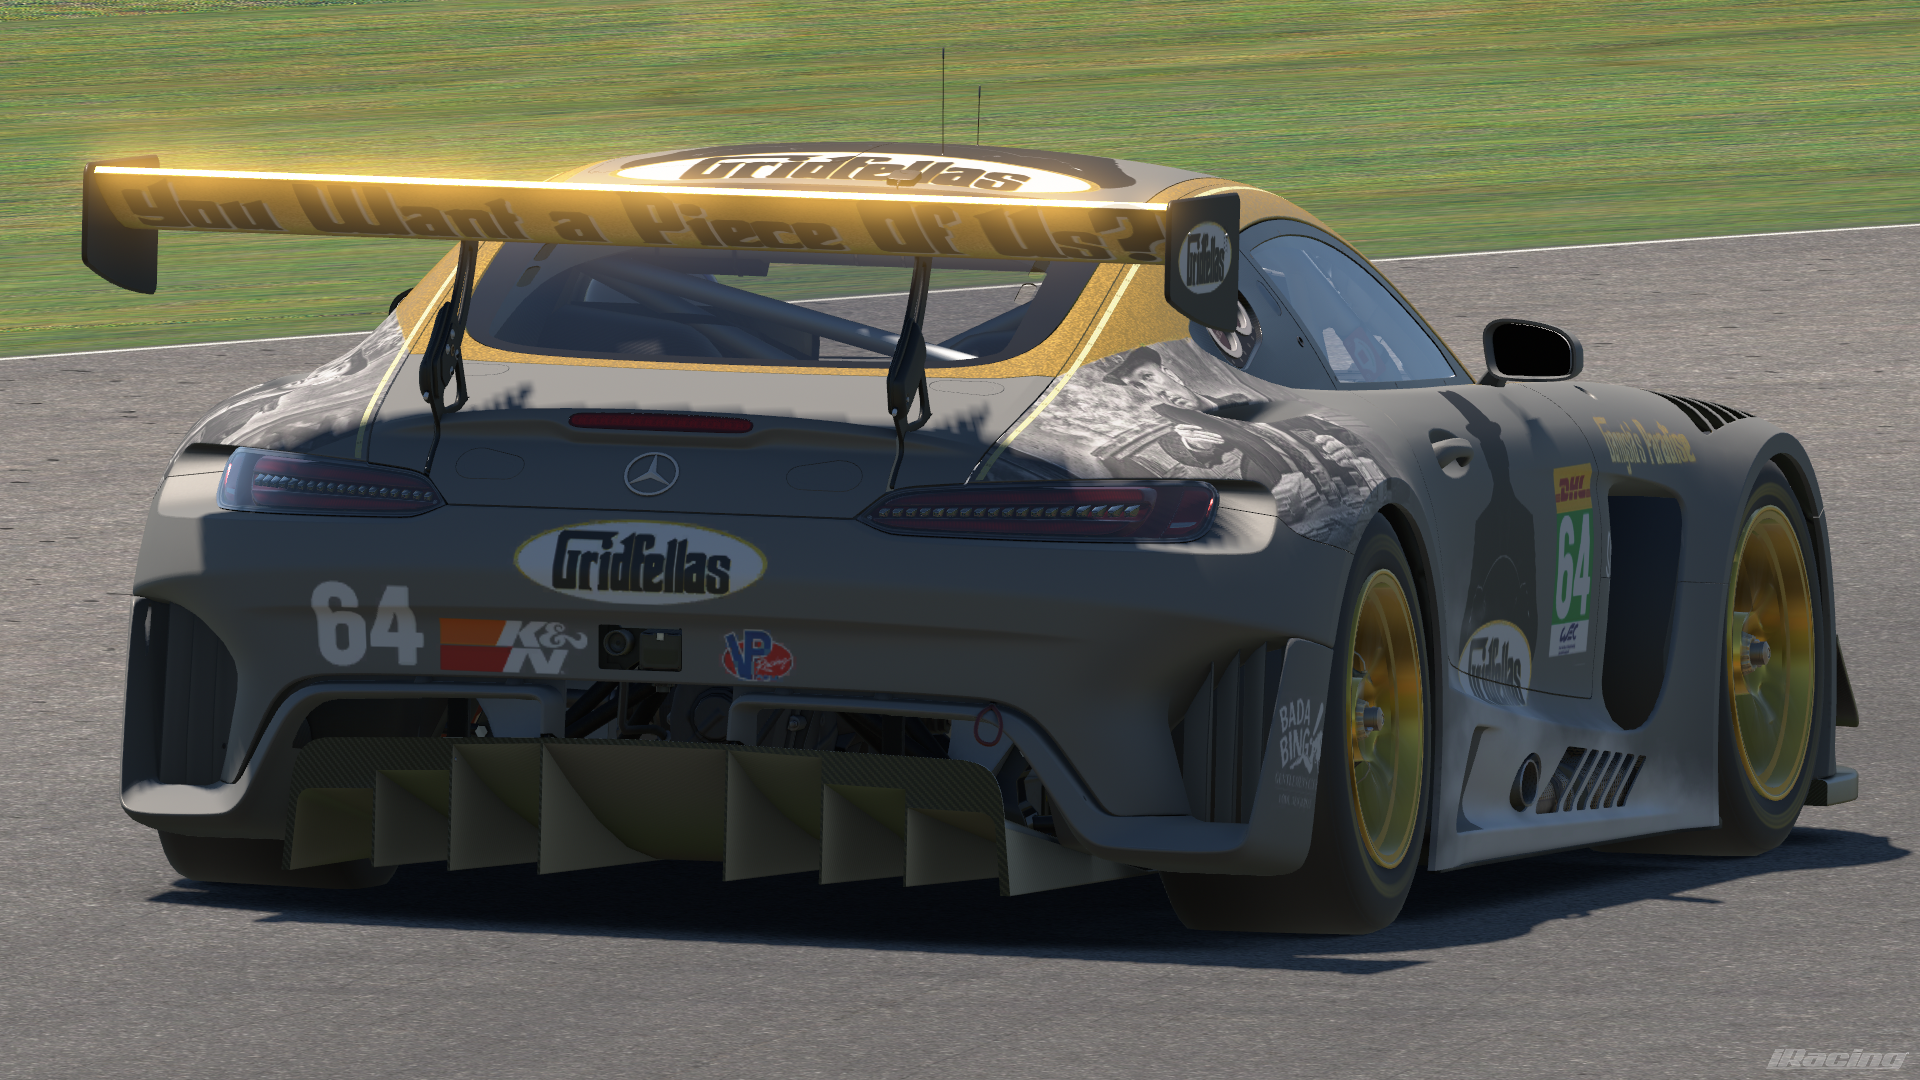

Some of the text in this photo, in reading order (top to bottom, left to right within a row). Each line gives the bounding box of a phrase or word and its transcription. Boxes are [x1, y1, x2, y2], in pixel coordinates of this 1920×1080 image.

[679, 154, 1032, 192] Gridfellas
[121, 178, 1166, 262] You Want a Piece Of Us?
[1187, 232, 1225, 286] Gridfellas
[1632, 419, 1697, 465] Paradise
[1559, 475, 1586, 502] DHL
[552, 529, 731, 595] Gridfellas
[1556, 513, 1591, 620] 64
[311, 580, 424, 666] 64
[724, 629, 773, 680] VP
[1279, 698, 1311, 733] BADA
